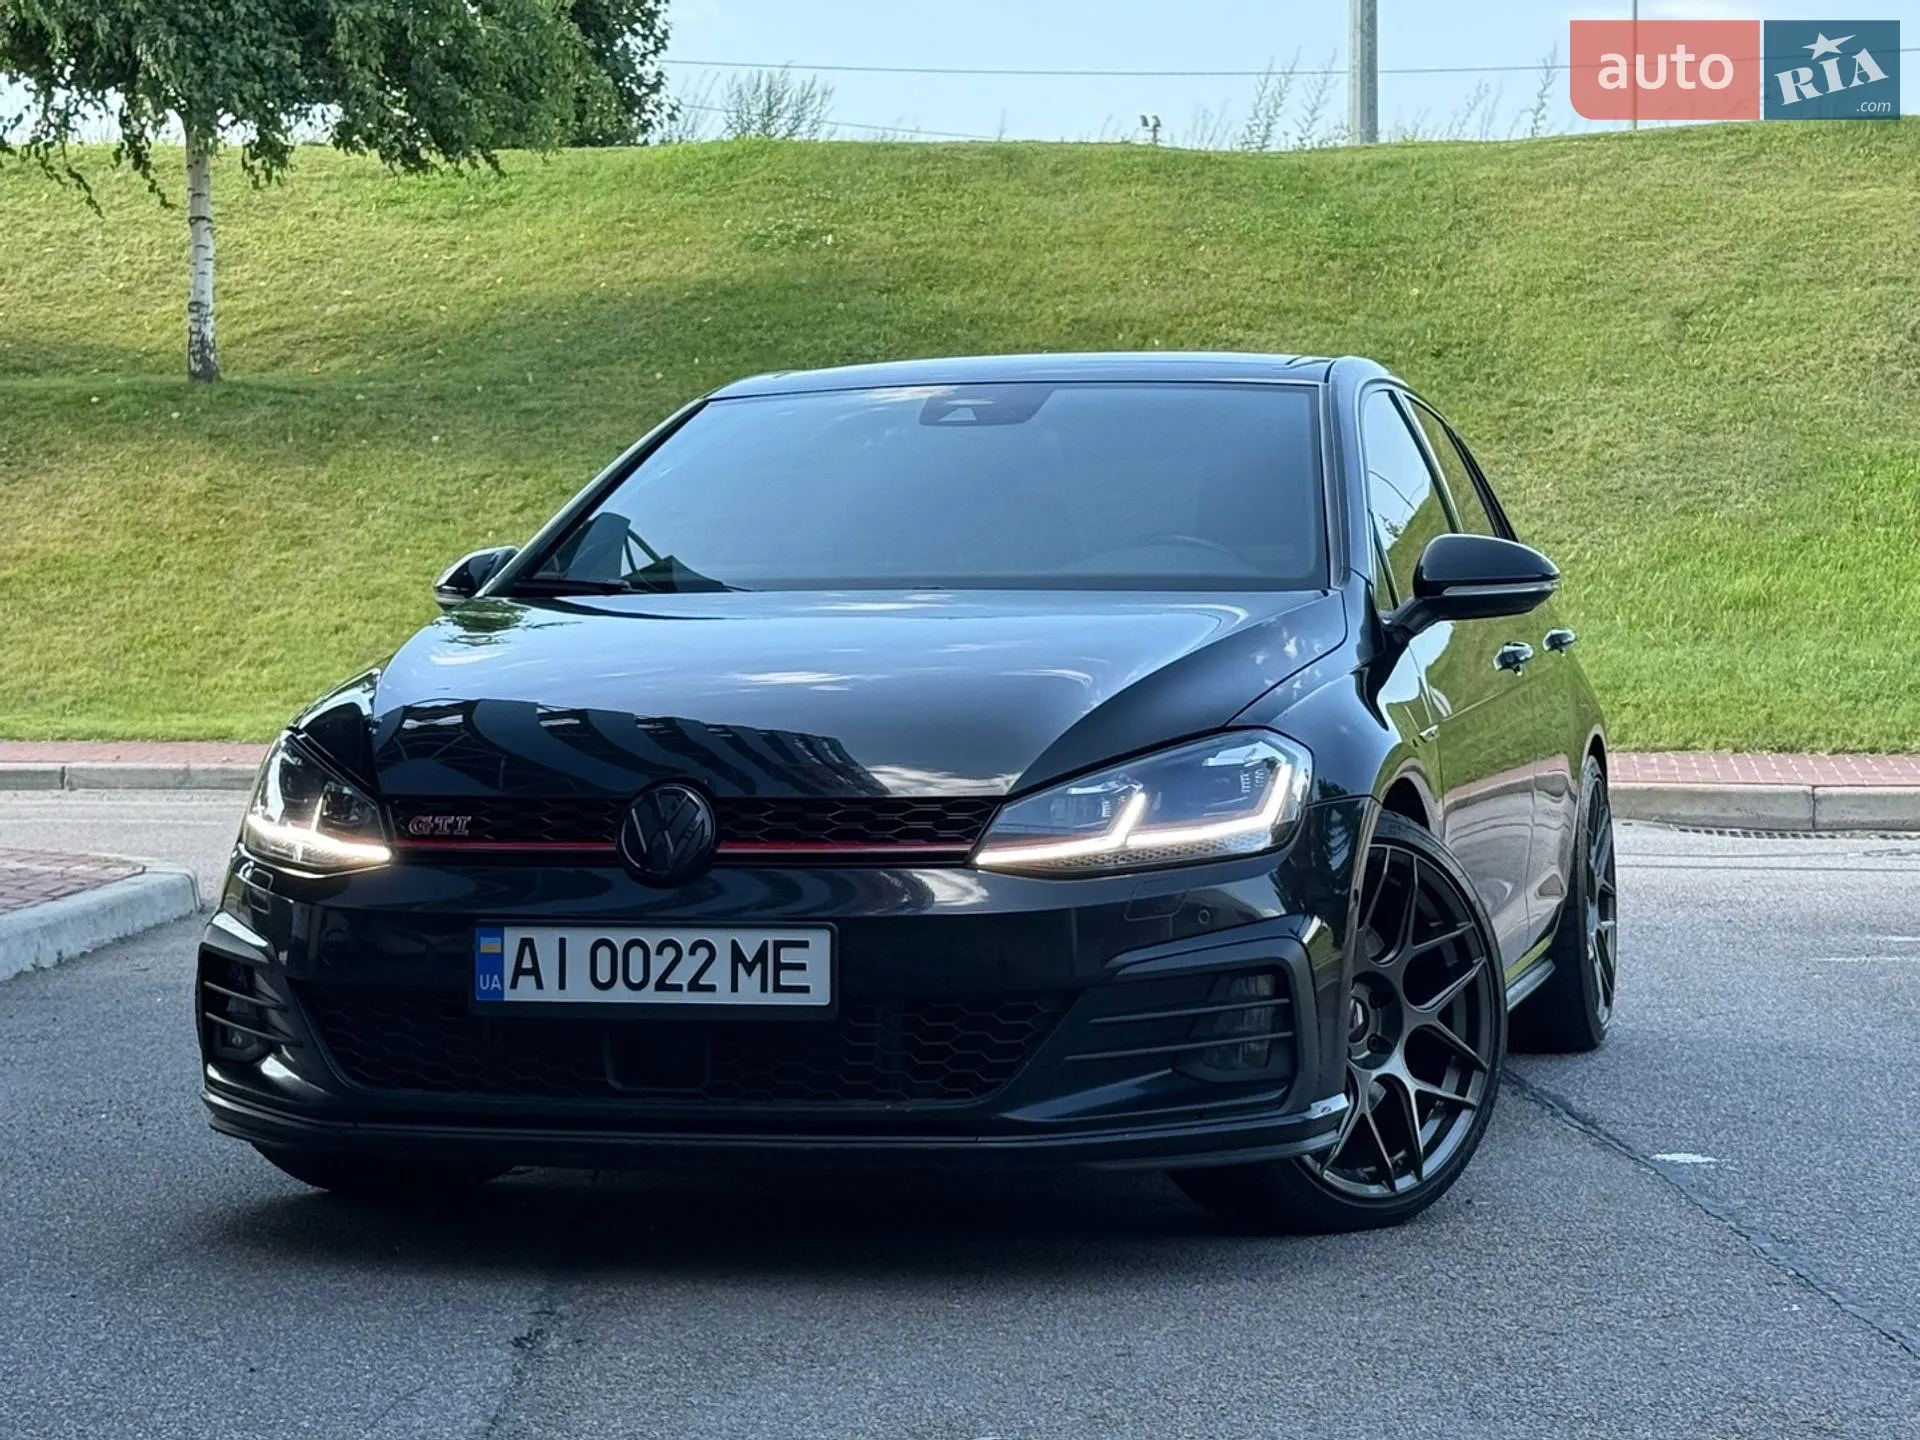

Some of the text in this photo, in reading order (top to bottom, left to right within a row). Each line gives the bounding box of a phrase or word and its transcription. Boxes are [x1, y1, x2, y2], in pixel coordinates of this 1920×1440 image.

[408, 815, 472, 836] GTI
[509, 937, 811, 994] AI 0022 ME
[479, 974, 502, 991] UA
